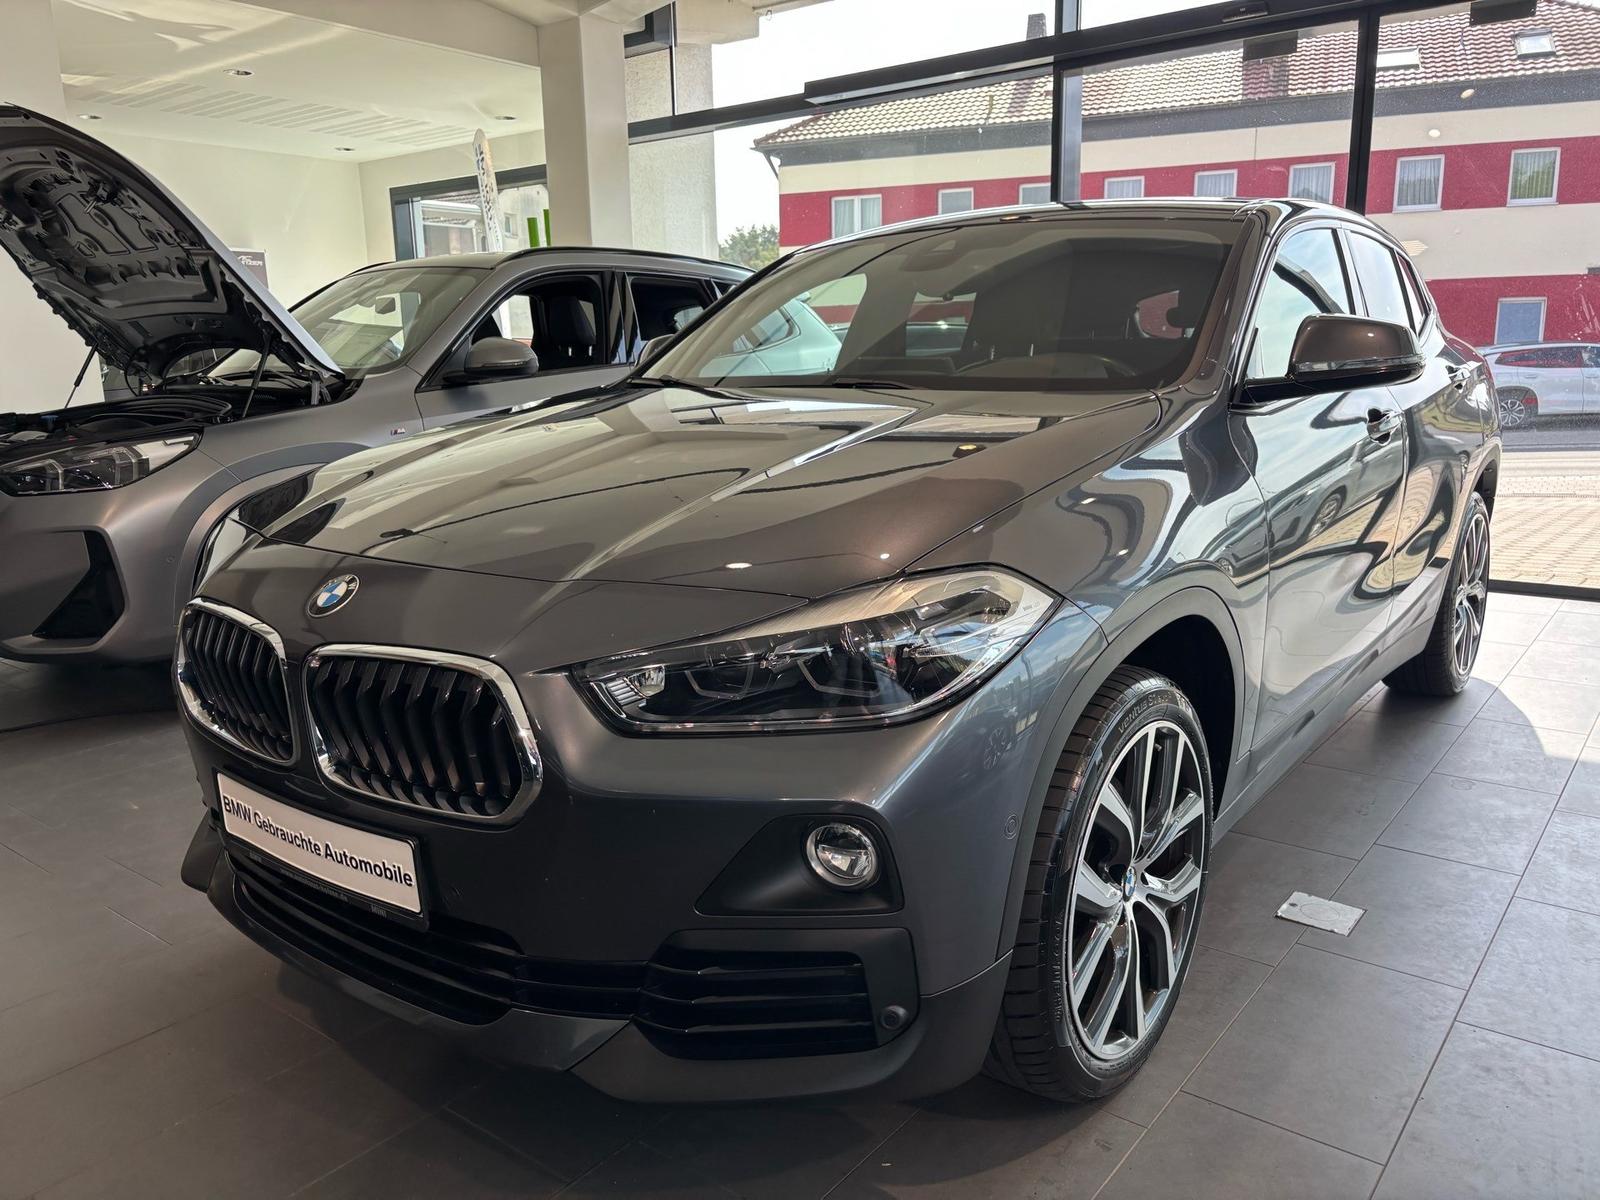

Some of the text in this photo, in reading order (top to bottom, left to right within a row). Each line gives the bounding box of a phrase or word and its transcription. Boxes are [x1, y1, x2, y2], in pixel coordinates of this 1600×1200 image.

[223, 795, 252, 824] BMW
[253, 812, 322, 857] Gebrauchte
[324, 843, 414, 887] Automobile
